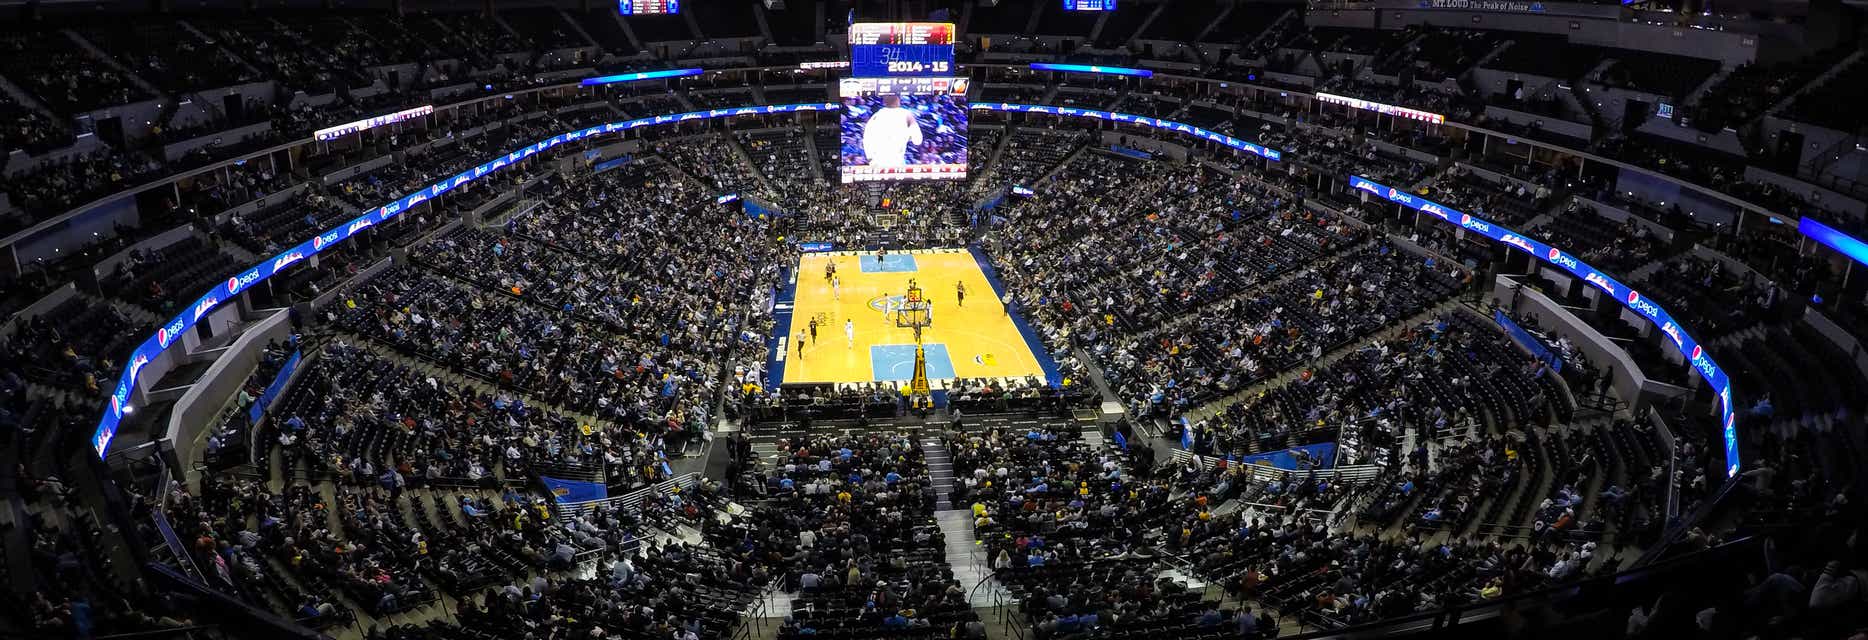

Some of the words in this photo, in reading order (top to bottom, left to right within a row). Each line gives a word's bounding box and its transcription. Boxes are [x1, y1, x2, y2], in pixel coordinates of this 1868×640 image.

[1447, 0, 1469, 8] LOUD
[1483, 2, 1499, 10] Peak
[888, 61, 923, 72] 2014
[932, 61, 948, 72] 15
[1396, 193, 1411, 204] pepsi
[1471, 220, 1489, 233] pepsi
[321, 232, 338, 246] pepsi
[1560, 256, 1577, 270] pepsi
[239, 268, 259, 288] pepsi
[1638, 300, 1658, 318] pepsi
[167, 319, 185, 341] pepsi
[1699, 357, 1716, 378] pepsi
